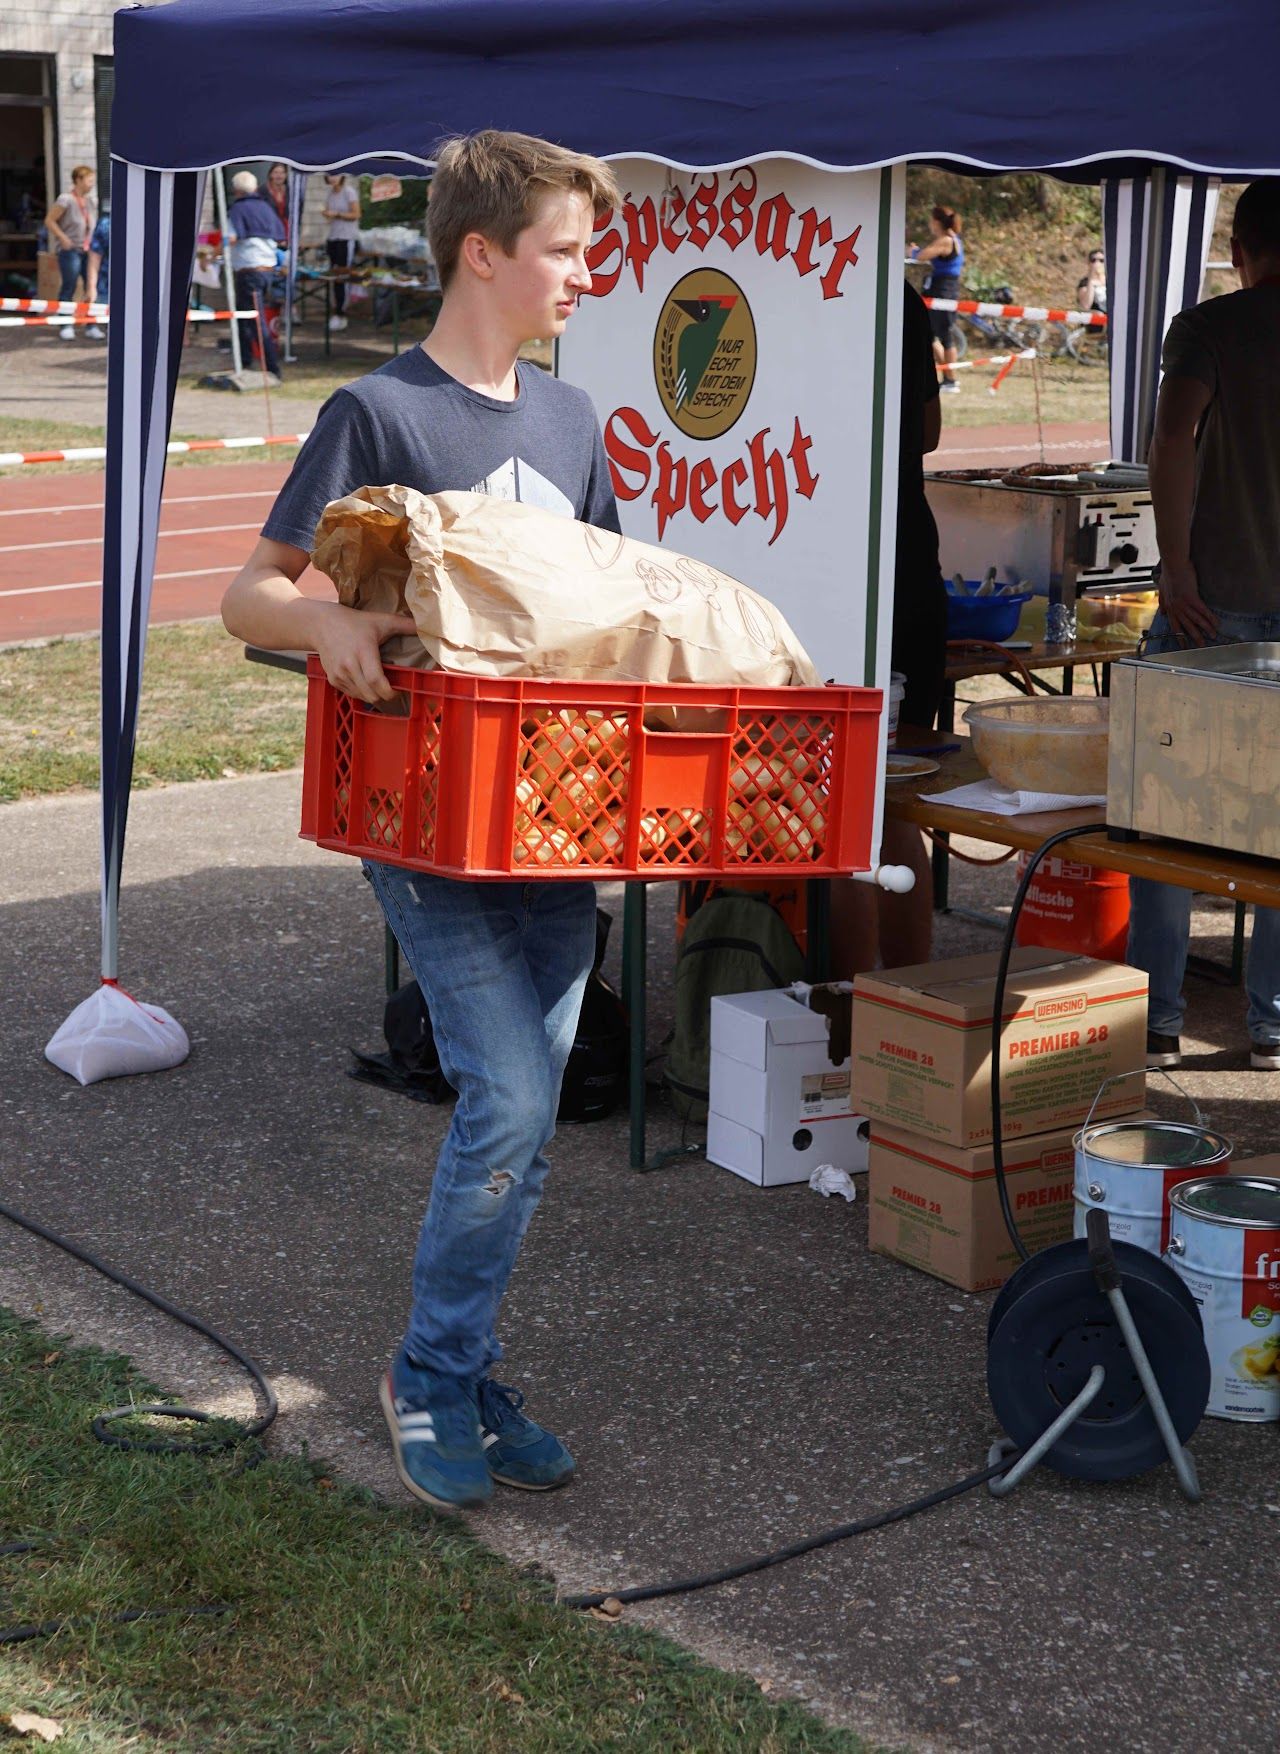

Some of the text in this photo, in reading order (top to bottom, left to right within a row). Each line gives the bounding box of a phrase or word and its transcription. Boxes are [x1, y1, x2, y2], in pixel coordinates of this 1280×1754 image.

[577, 165, 862, 308] Spessart
[717, 339, 745, 353] NUR
[708, 357, 742, 371] ECHT
[700, 374, 747, 390] MIT DEM
[693, 392, 738, 407] SPECHT
[604, 406, 820, 546] Specht
[1037, 998, 1084, 1017] WERNSING
[880, 1040, 934, 1066] PREMIER 28
[1009, 1030, 1081, 1060] PREMIER
[1086, 1024, 1110, 1045] 28
[1045, 1150, 1075, 1167] WERNS
[892, 1185, 942, 1215] PREMIER 28
[1016, 1182, 1075, 1210] PREMI
